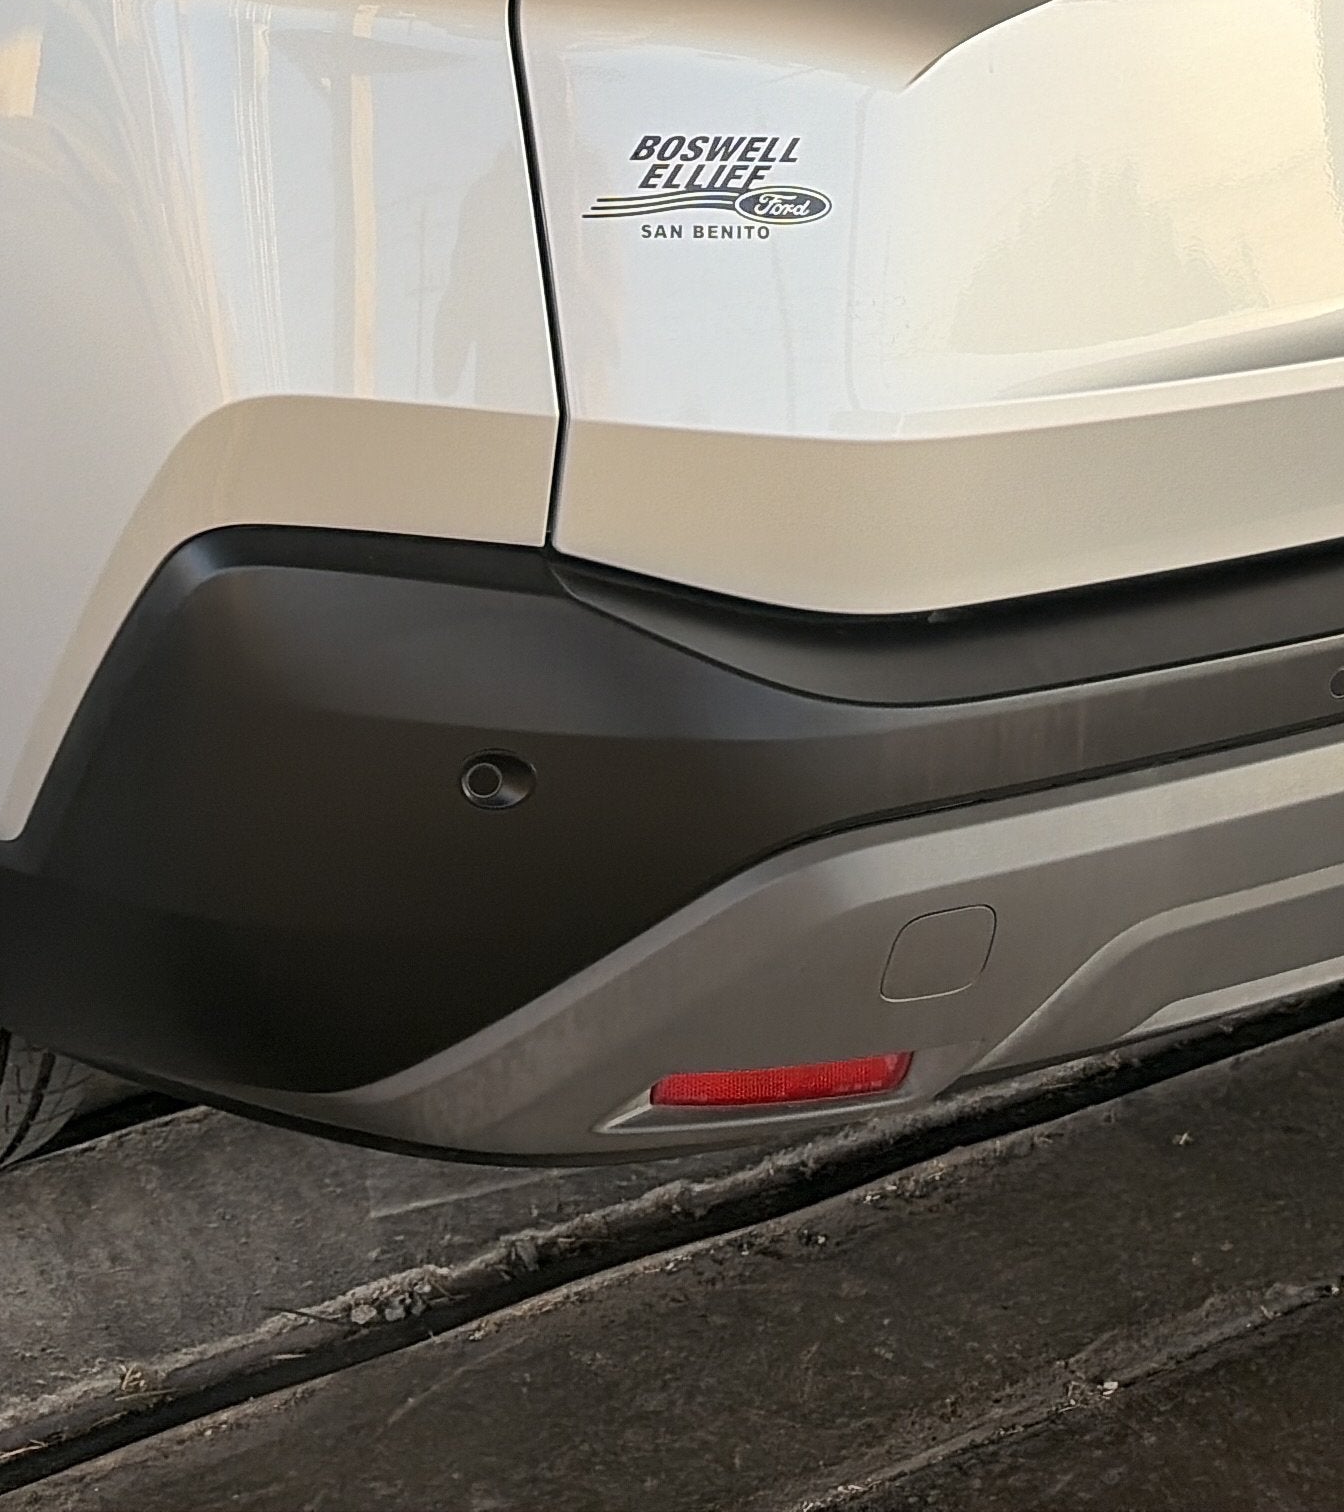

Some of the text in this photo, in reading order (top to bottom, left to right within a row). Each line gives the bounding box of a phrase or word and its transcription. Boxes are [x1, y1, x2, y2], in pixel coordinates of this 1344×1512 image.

[629, 134, 801, 163] BOSWELL
[637, 163, 773, 190] ELLIFF
[753, 192, 811, 218] Ford
[640, 224, 771, 240] SAN BENITO
